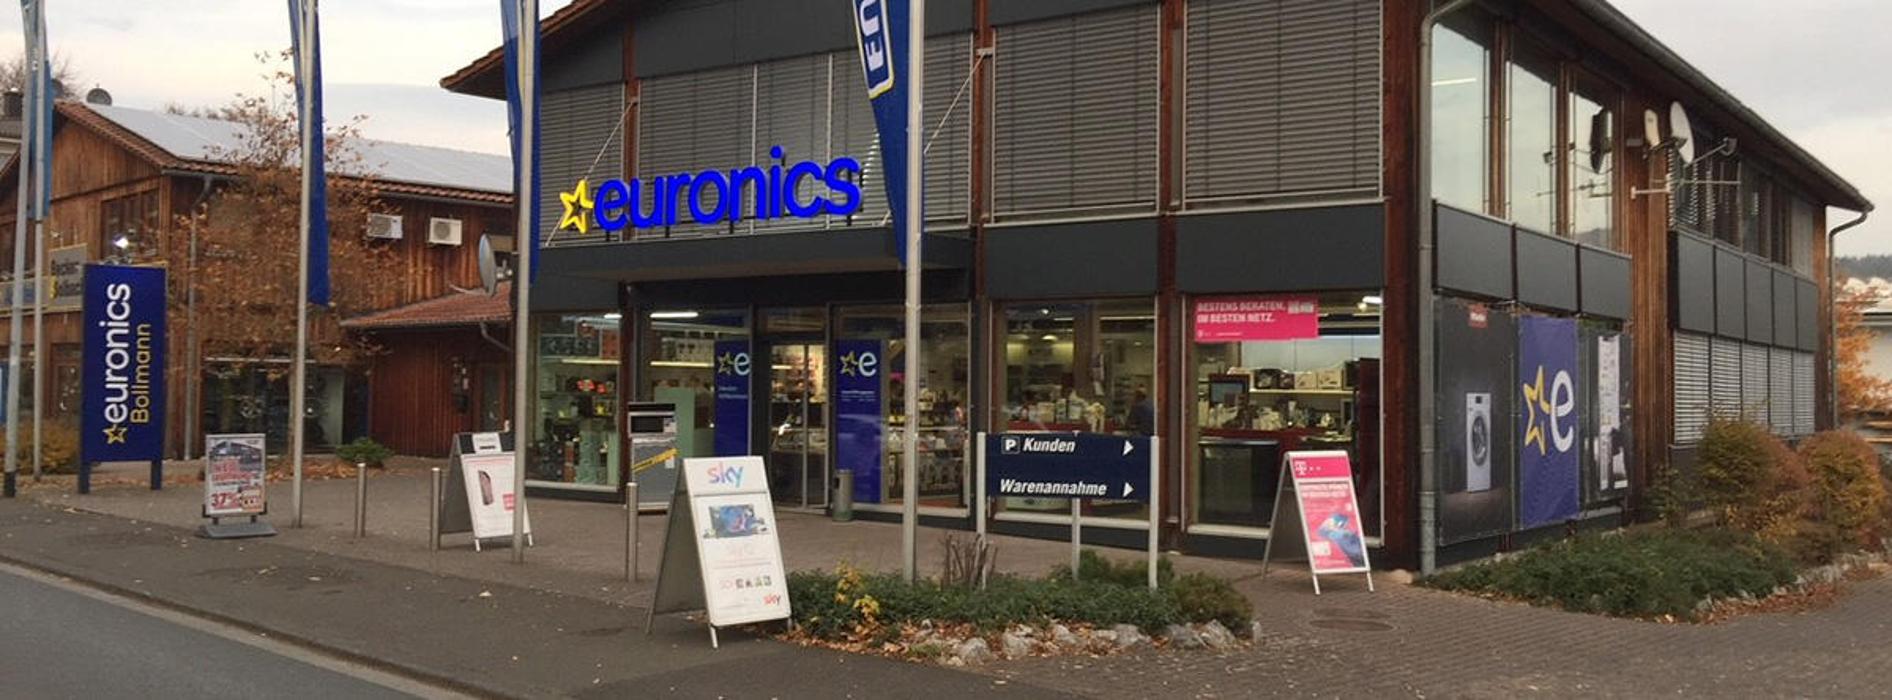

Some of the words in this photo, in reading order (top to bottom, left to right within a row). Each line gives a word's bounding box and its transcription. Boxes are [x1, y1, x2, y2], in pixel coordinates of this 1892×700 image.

[594, 145, 862, 231] euronics
[1198, 302, 1238, 312] BESTENS
[1210, 313, 1246, 323] BESTEN
[99, 283, 131, 424] euronics
[734, 352, 750, 376] e
[858, 352, 877, 376] e
[131, 323, 152, 424] Bollmann
[1551, 370, 1574, 452] e
[1005, 439, 1017, 451] P
[1023, 437, 1076, 453] Kunden
[707, 461, 744, 488] sky
[1000, 478, 1107, 496] Warenannahme
[763, 593, 781, 606] sky
